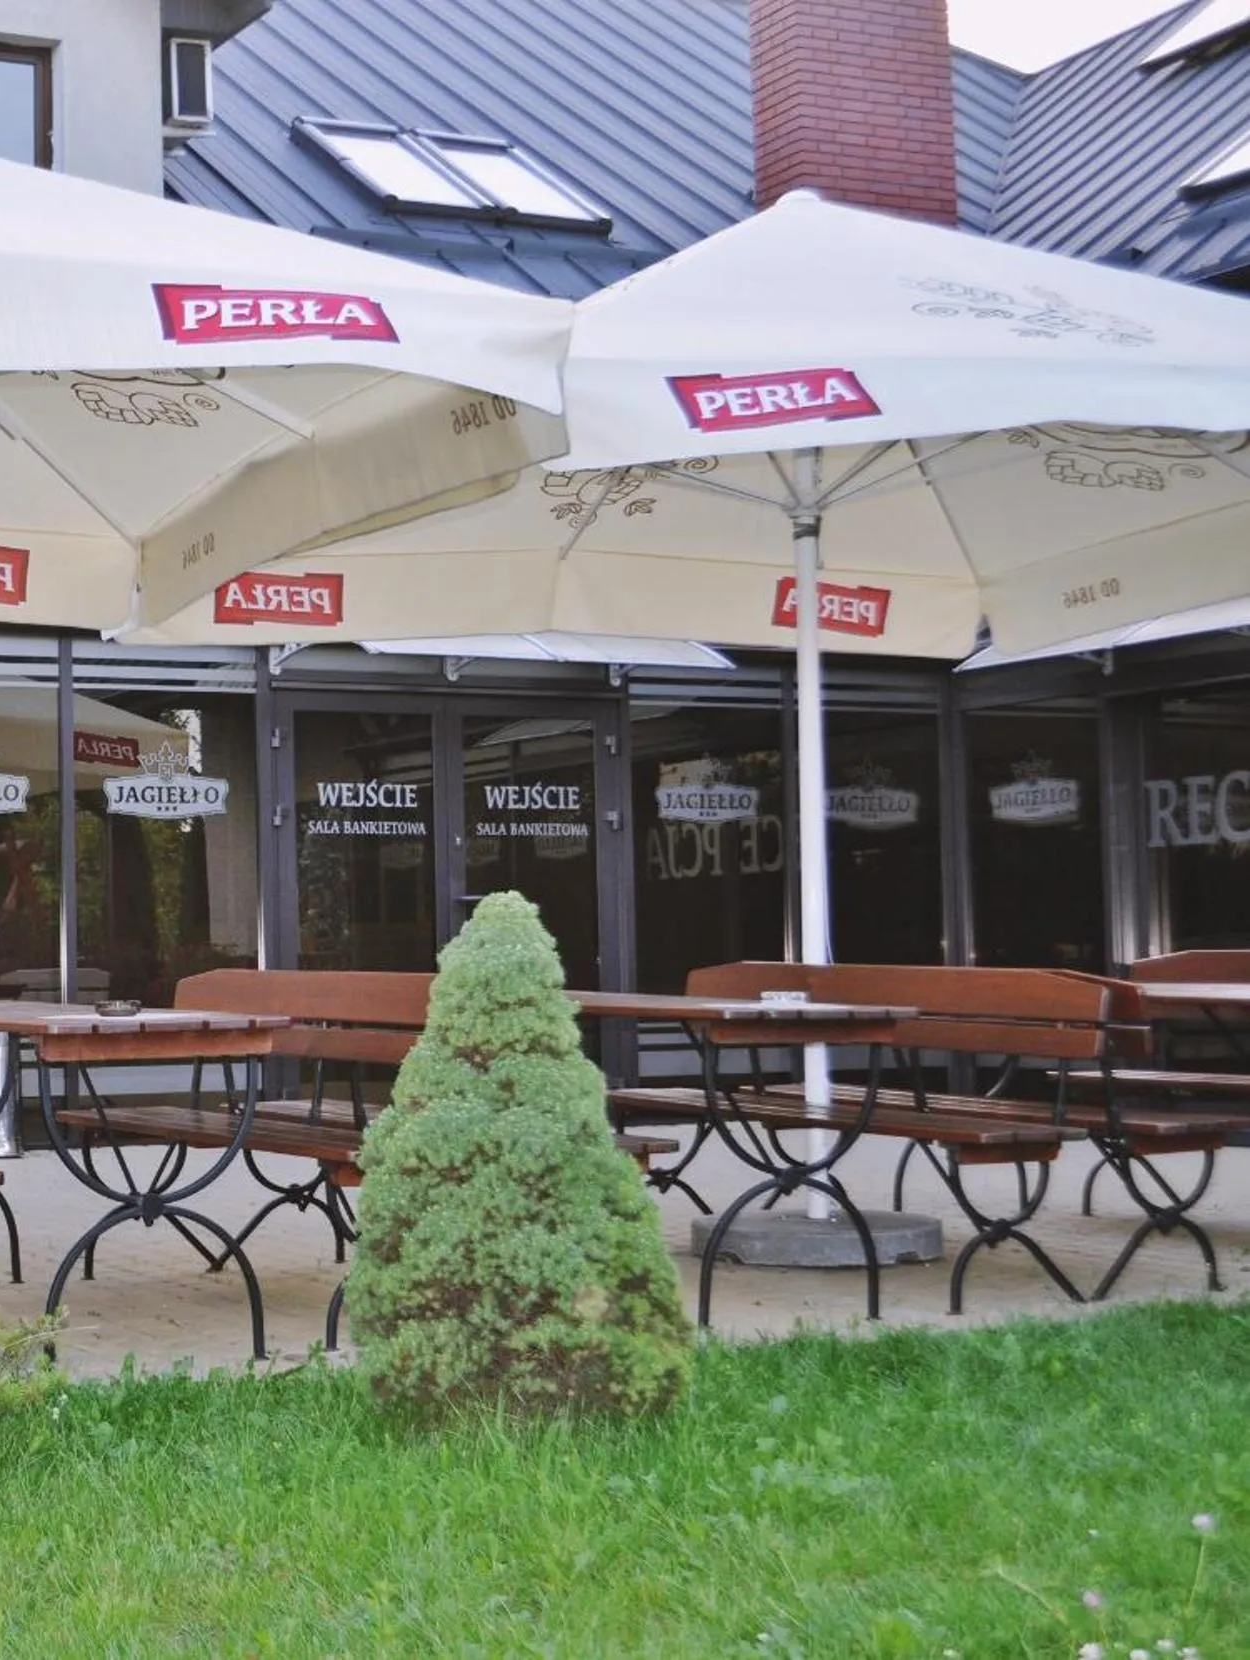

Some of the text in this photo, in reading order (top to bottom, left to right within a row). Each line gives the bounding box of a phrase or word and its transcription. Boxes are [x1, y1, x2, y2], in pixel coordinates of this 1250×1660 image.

[180, 298, 378, 331] PERŁA
[693, 376, 859, 419] PERŁA
[113, 785, 220, 804] JAGIEŁŁO
[316, 779, 418, 808] WEJŚCIE
[484, 781, 581, 810] WEJŚCIE
[662, 792, 751, 811] JAGIEŁŁO
[307, 820, 427, 836] SALA BANKIETOWA
[475, 822, 589, 837] SALA BANKIETOWA
